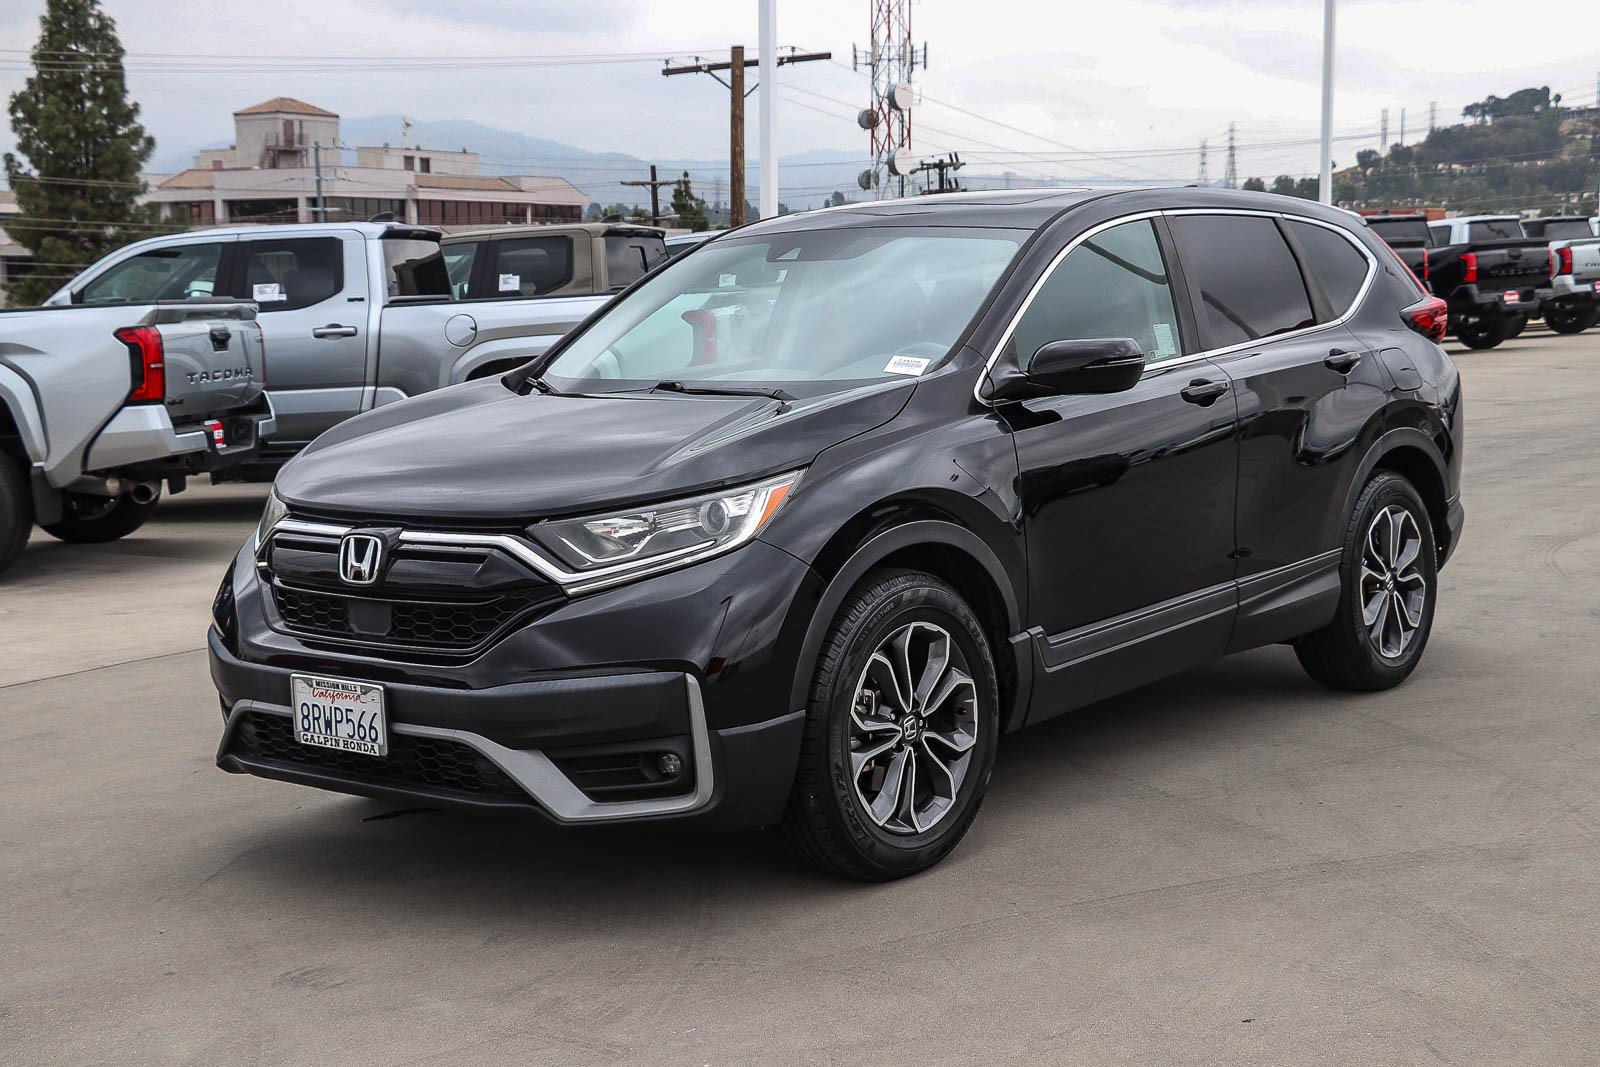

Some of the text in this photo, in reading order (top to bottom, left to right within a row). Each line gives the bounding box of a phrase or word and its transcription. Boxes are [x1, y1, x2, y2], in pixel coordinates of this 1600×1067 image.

[186, 367, 254, 385] TACOMA
[315, 680, 340, 689] MISSION
[312, 687, 367, 704] California
[301, 702, 379, 743] 8RWP566
[302, 733, 377, 755] GALPIN HONDA
